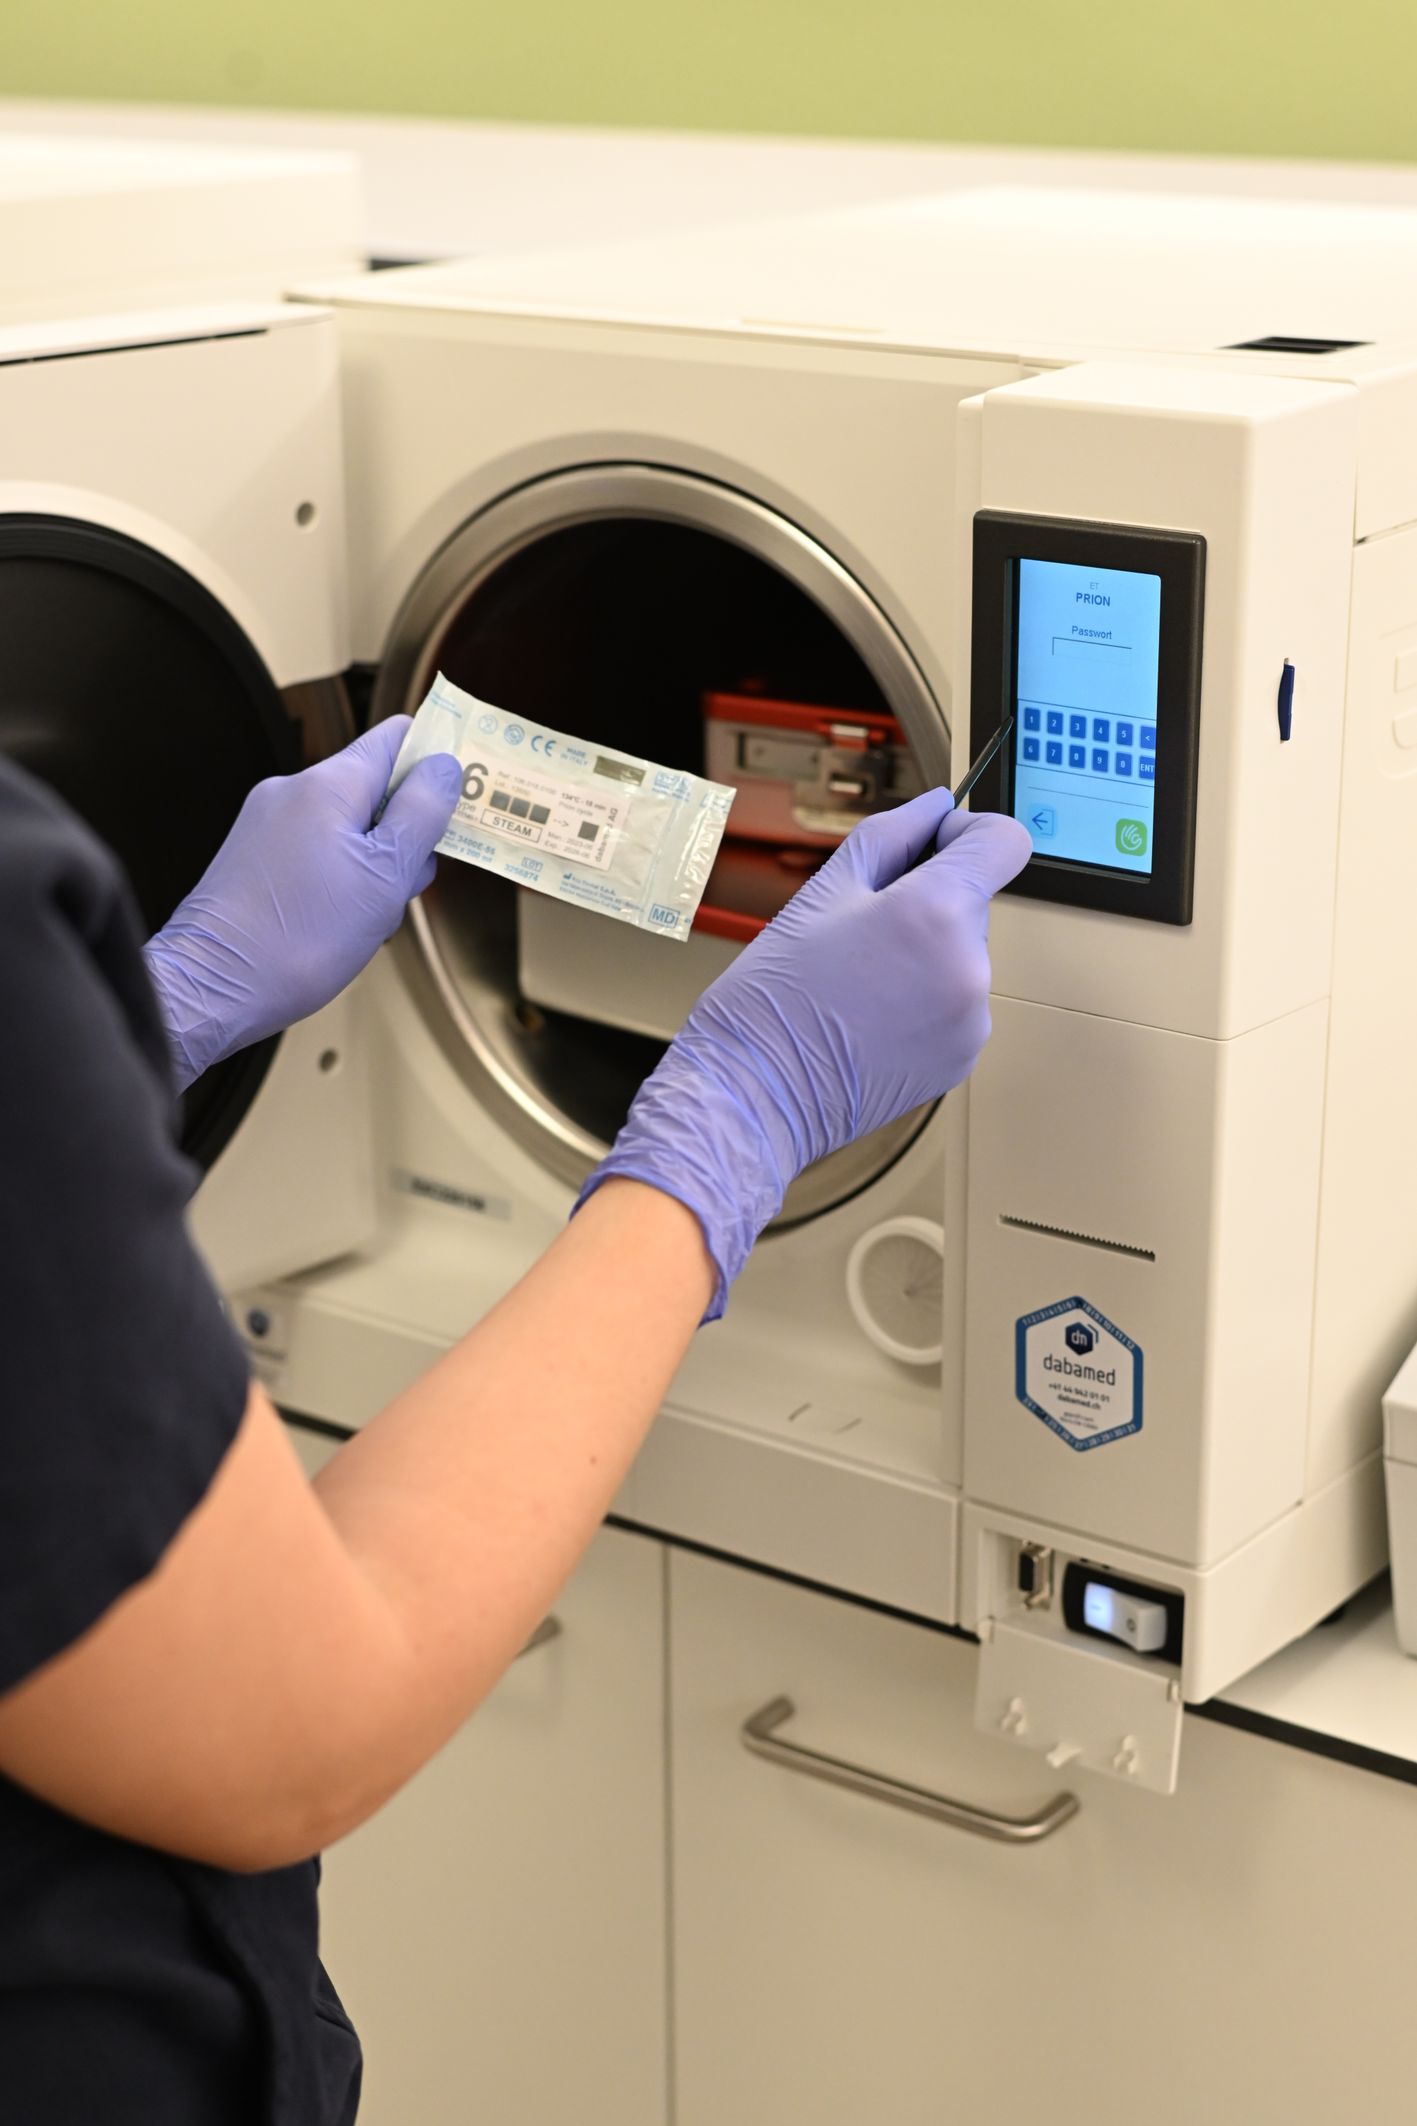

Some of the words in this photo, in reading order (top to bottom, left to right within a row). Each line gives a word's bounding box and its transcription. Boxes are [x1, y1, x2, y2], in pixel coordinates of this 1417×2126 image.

[1089, 582, 1100, 591] ET
[1075, 592, 1111, 607] PRION
[1071, 625, 1112, 640] Passwort
[461, 762, 489, 801] 6
[492, 815, 533, 838] STEAM
[651, 907, 677, 925] MD
[1071, 1330, 1088, 1347] dn
[1043, 1353, 1116, 1386] dabamed
[1057, 1393, 1101, 1410] dabamed.ch
